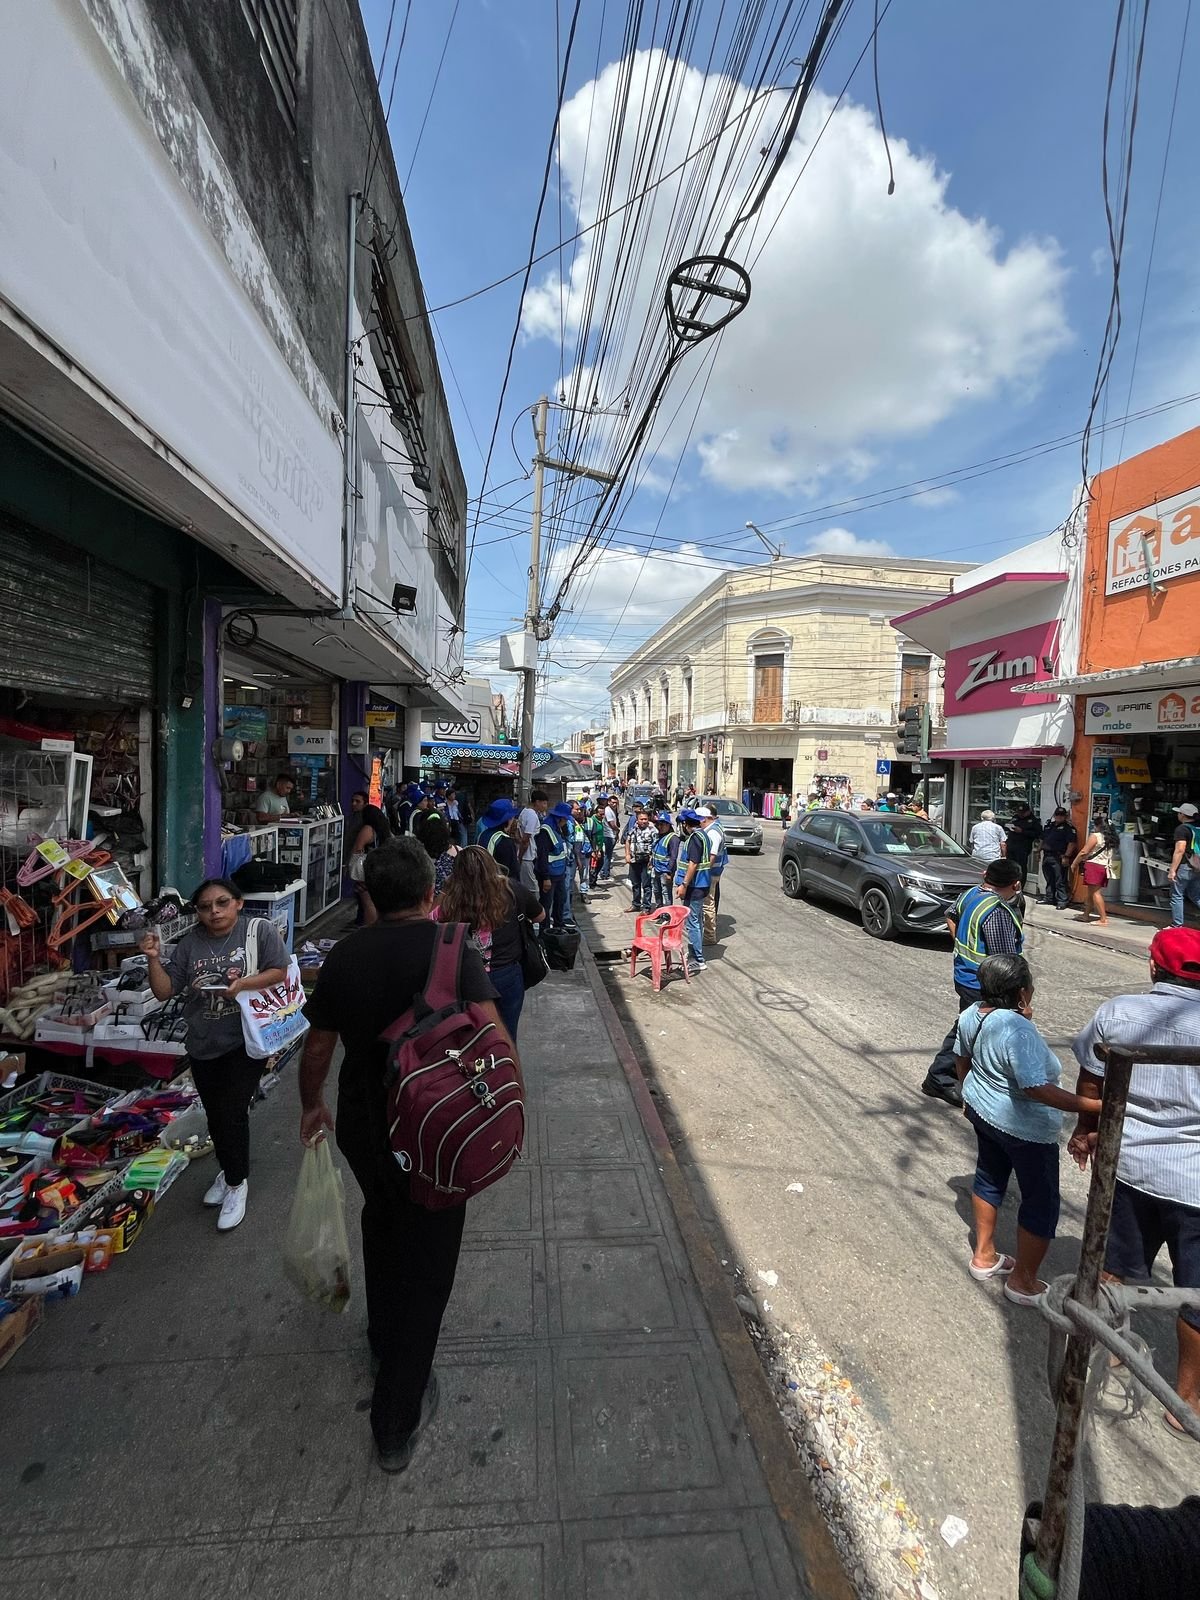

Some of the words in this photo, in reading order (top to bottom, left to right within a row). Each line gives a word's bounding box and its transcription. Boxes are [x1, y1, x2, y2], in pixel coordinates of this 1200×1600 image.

[1111, 562, 1181, 590] REFACCONES
[1184, 557, 1200, 569] PA
[956, 650, 1037, 701] Zum
[1102, 720, 1132, 731] mabe
